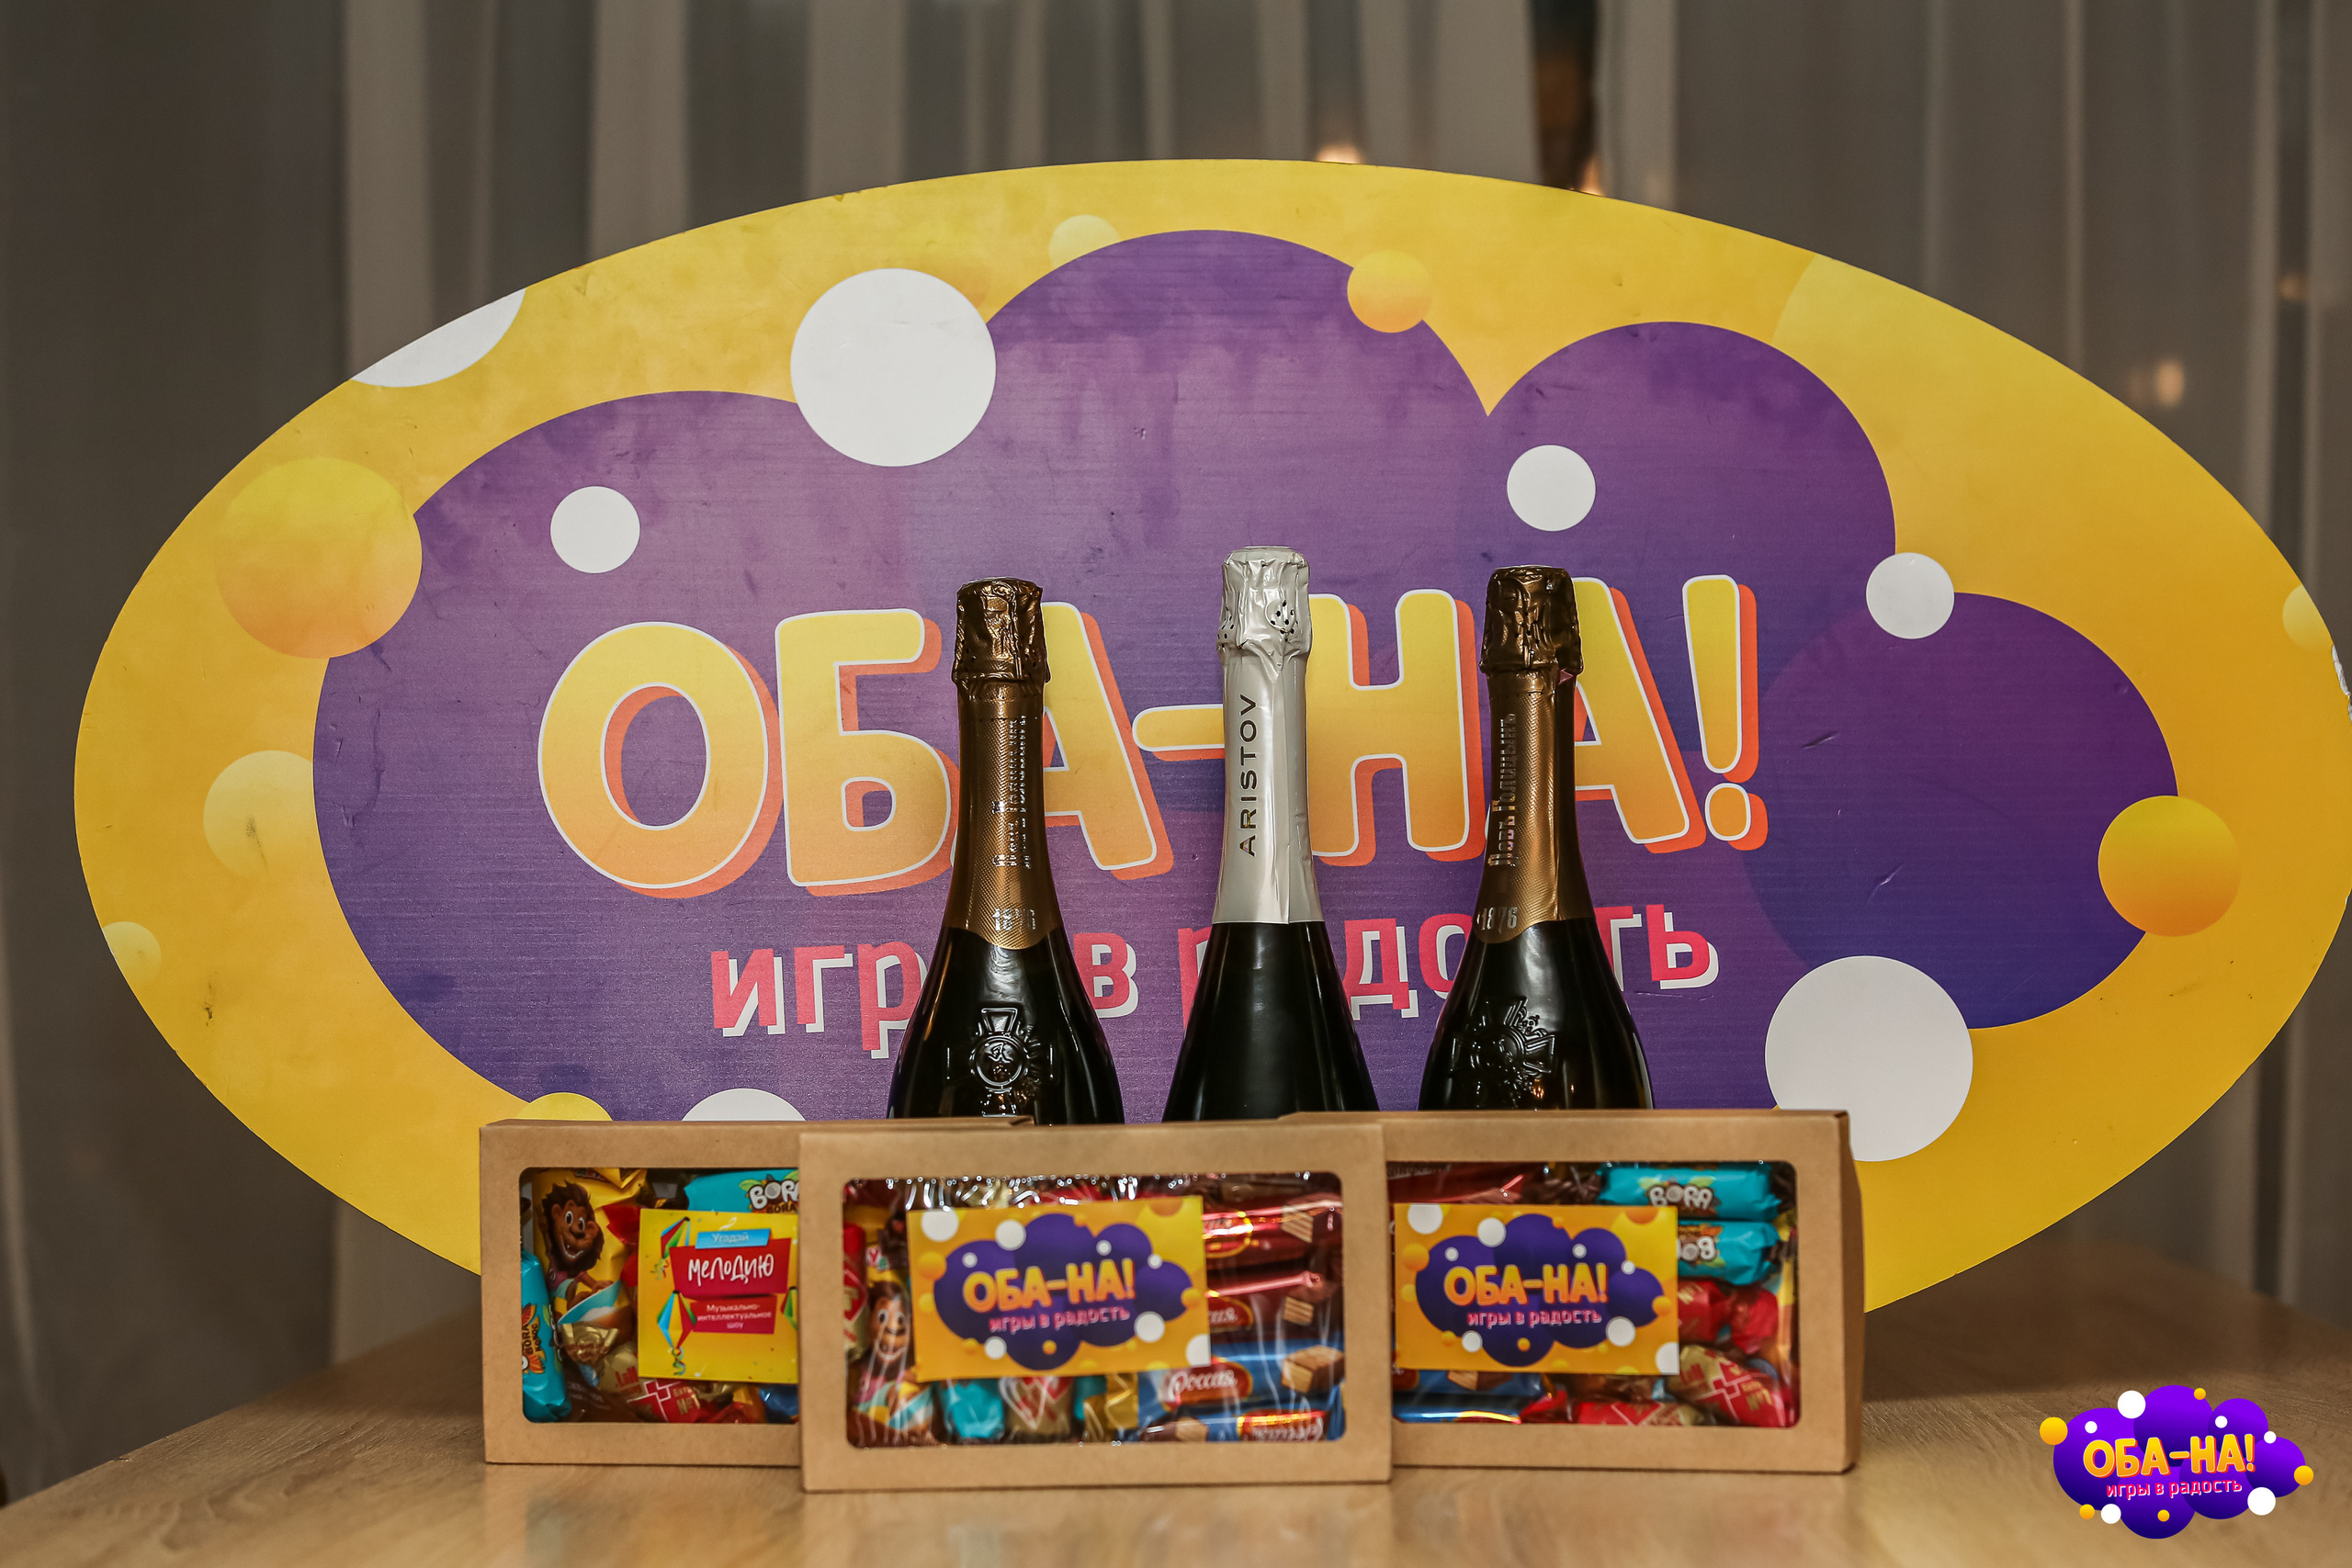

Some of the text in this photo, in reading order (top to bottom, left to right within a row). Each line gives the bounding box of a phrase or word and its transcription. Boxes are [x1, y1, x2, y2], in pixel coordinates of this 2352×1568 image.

[1238, 694, 1258, 858] ARISTOV
[710, 941, 930, 1059] игр
[1072, 931, 1139, 1019] в
[749, 1179, 799, 1210] BOR
[1649, 1185, 1713, 1211] BORA
[711, 1232, 750, 1243] Угадай
[962, 1258, 1136, 1314] ОБА-НА!
[1443, 1262, 1609, 1307] ОБА-НА!
[989, 1305, 1131, 1336] игры в радость
[1467, 1308, 1602, 1330] игры в радость
